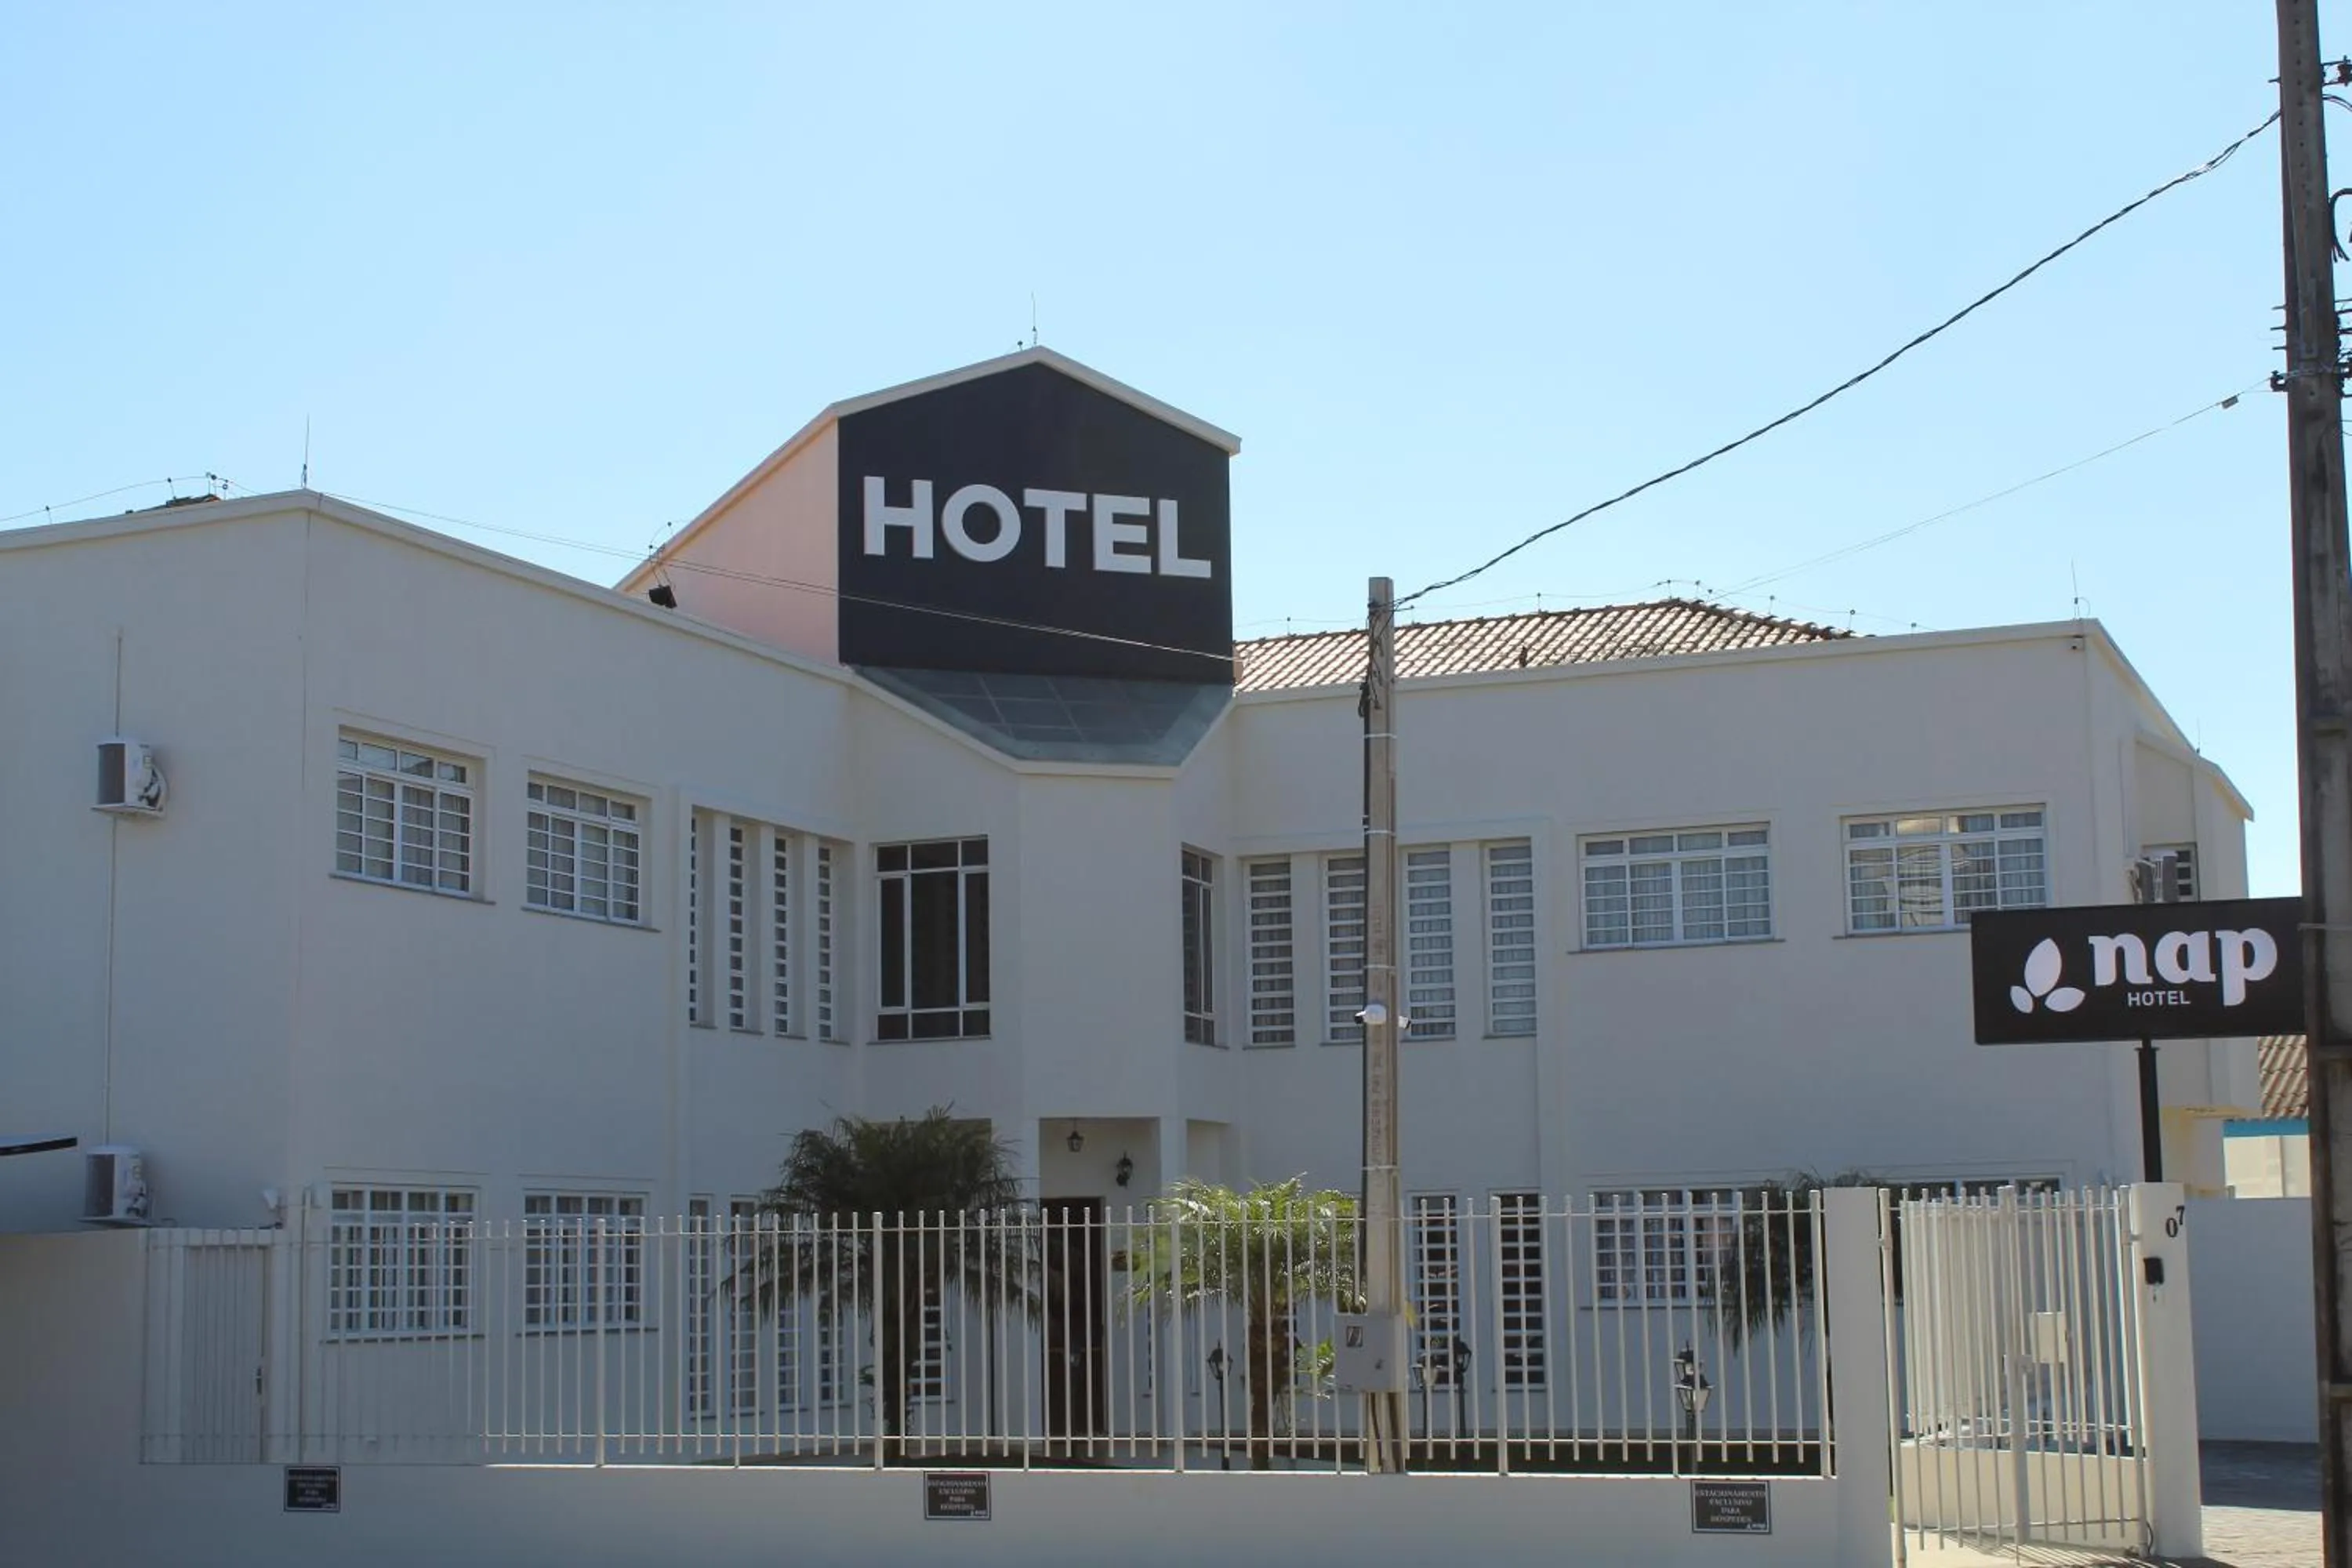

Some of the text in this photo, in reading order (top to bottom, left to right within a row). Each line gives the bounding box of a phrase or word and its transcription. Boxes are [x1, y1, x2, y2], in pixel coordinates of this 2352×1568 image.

[863, 475, 1212, 579] HOTEL
[2088, 927, 2278, 1007] nap
[2127, 990, 2192, 1007] HOTEL
